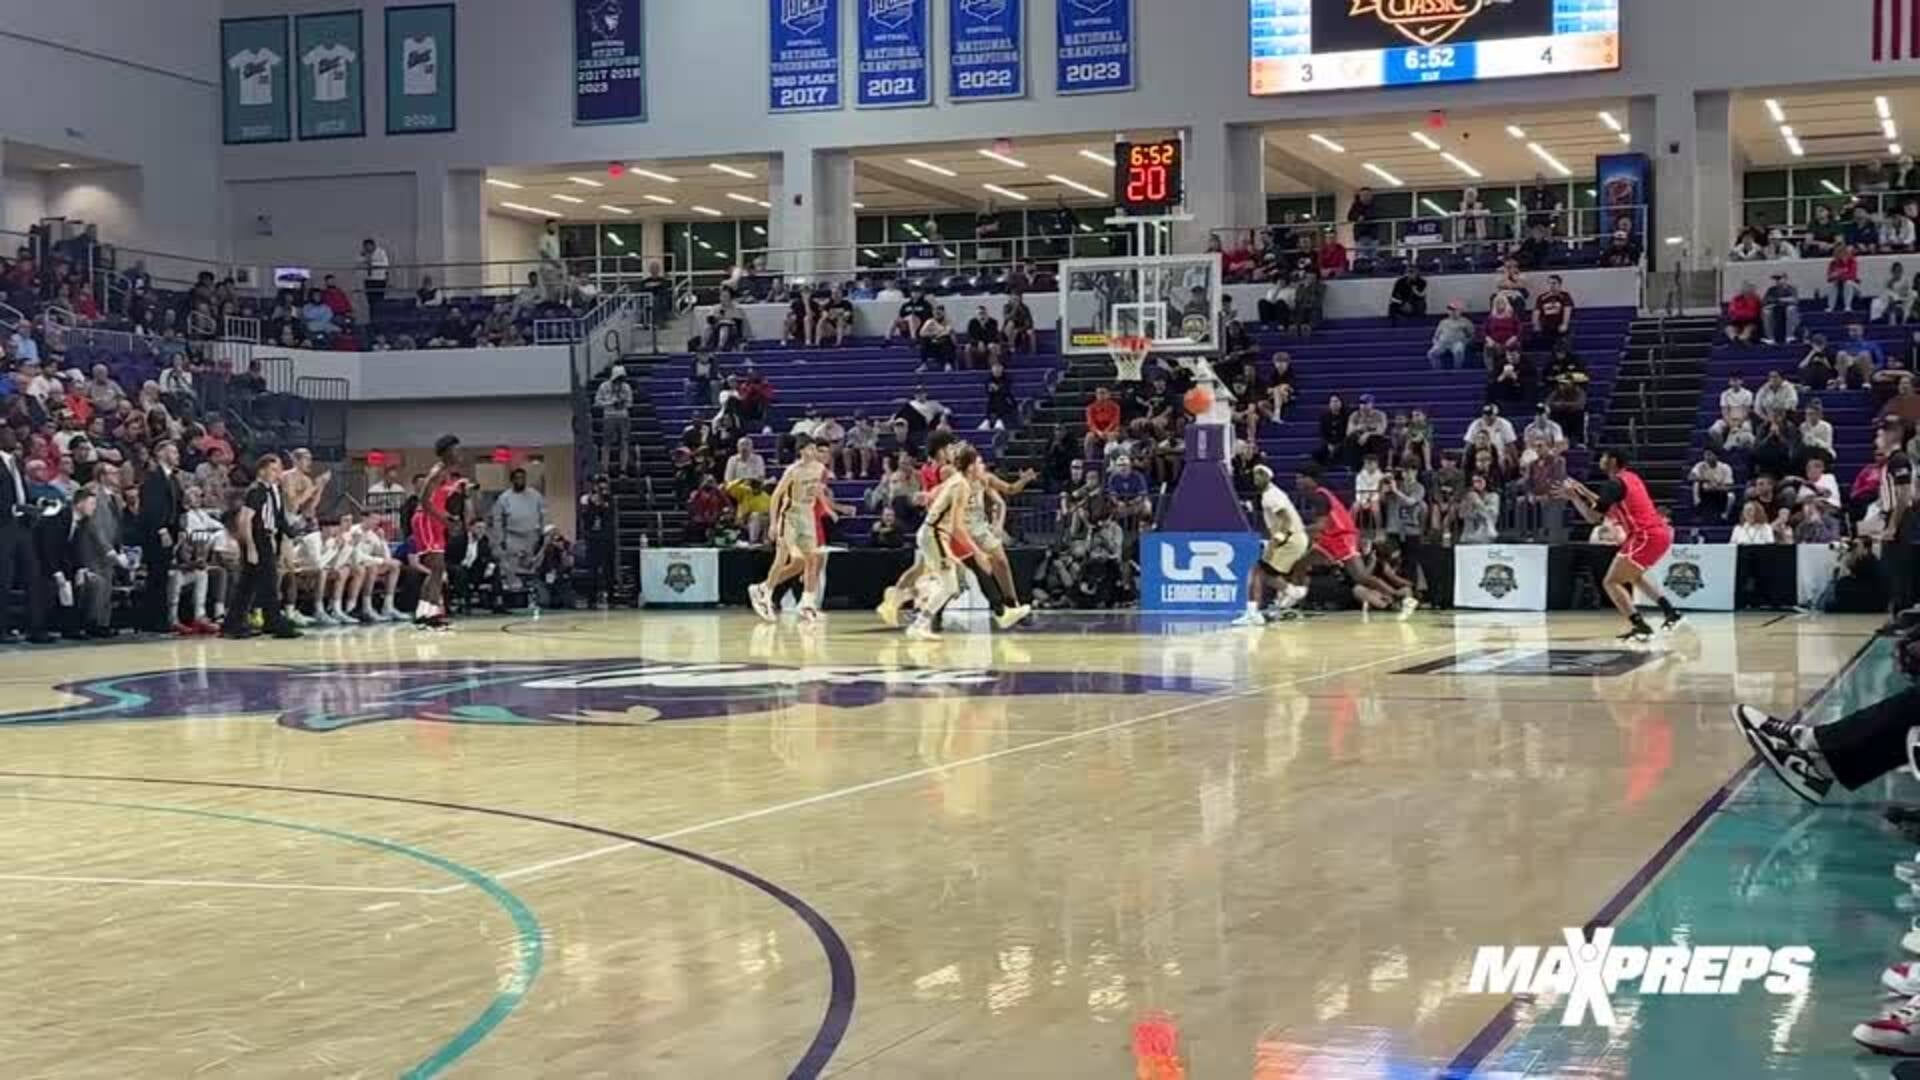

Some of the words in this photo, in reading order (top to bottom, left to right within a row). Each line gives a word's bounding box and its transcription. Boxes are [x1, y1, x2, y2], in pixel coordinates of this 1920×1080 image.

[1405, 47, 1456, 70] 6:52
[1540, 46, 1553, 64] 4
[798, 73, 837, 86] PLACE
[958, 70, 1012, 89] 2022
[1066, 62, 1121, 83] 2023
[1301, 63, 1314, 83] 3
[781, 87, 828, 106] 2017
[867, 78, 916, 96] 2021
[1131, 146, 1173, 165] 6:52
[1128, 167, 1166, 200] 20
